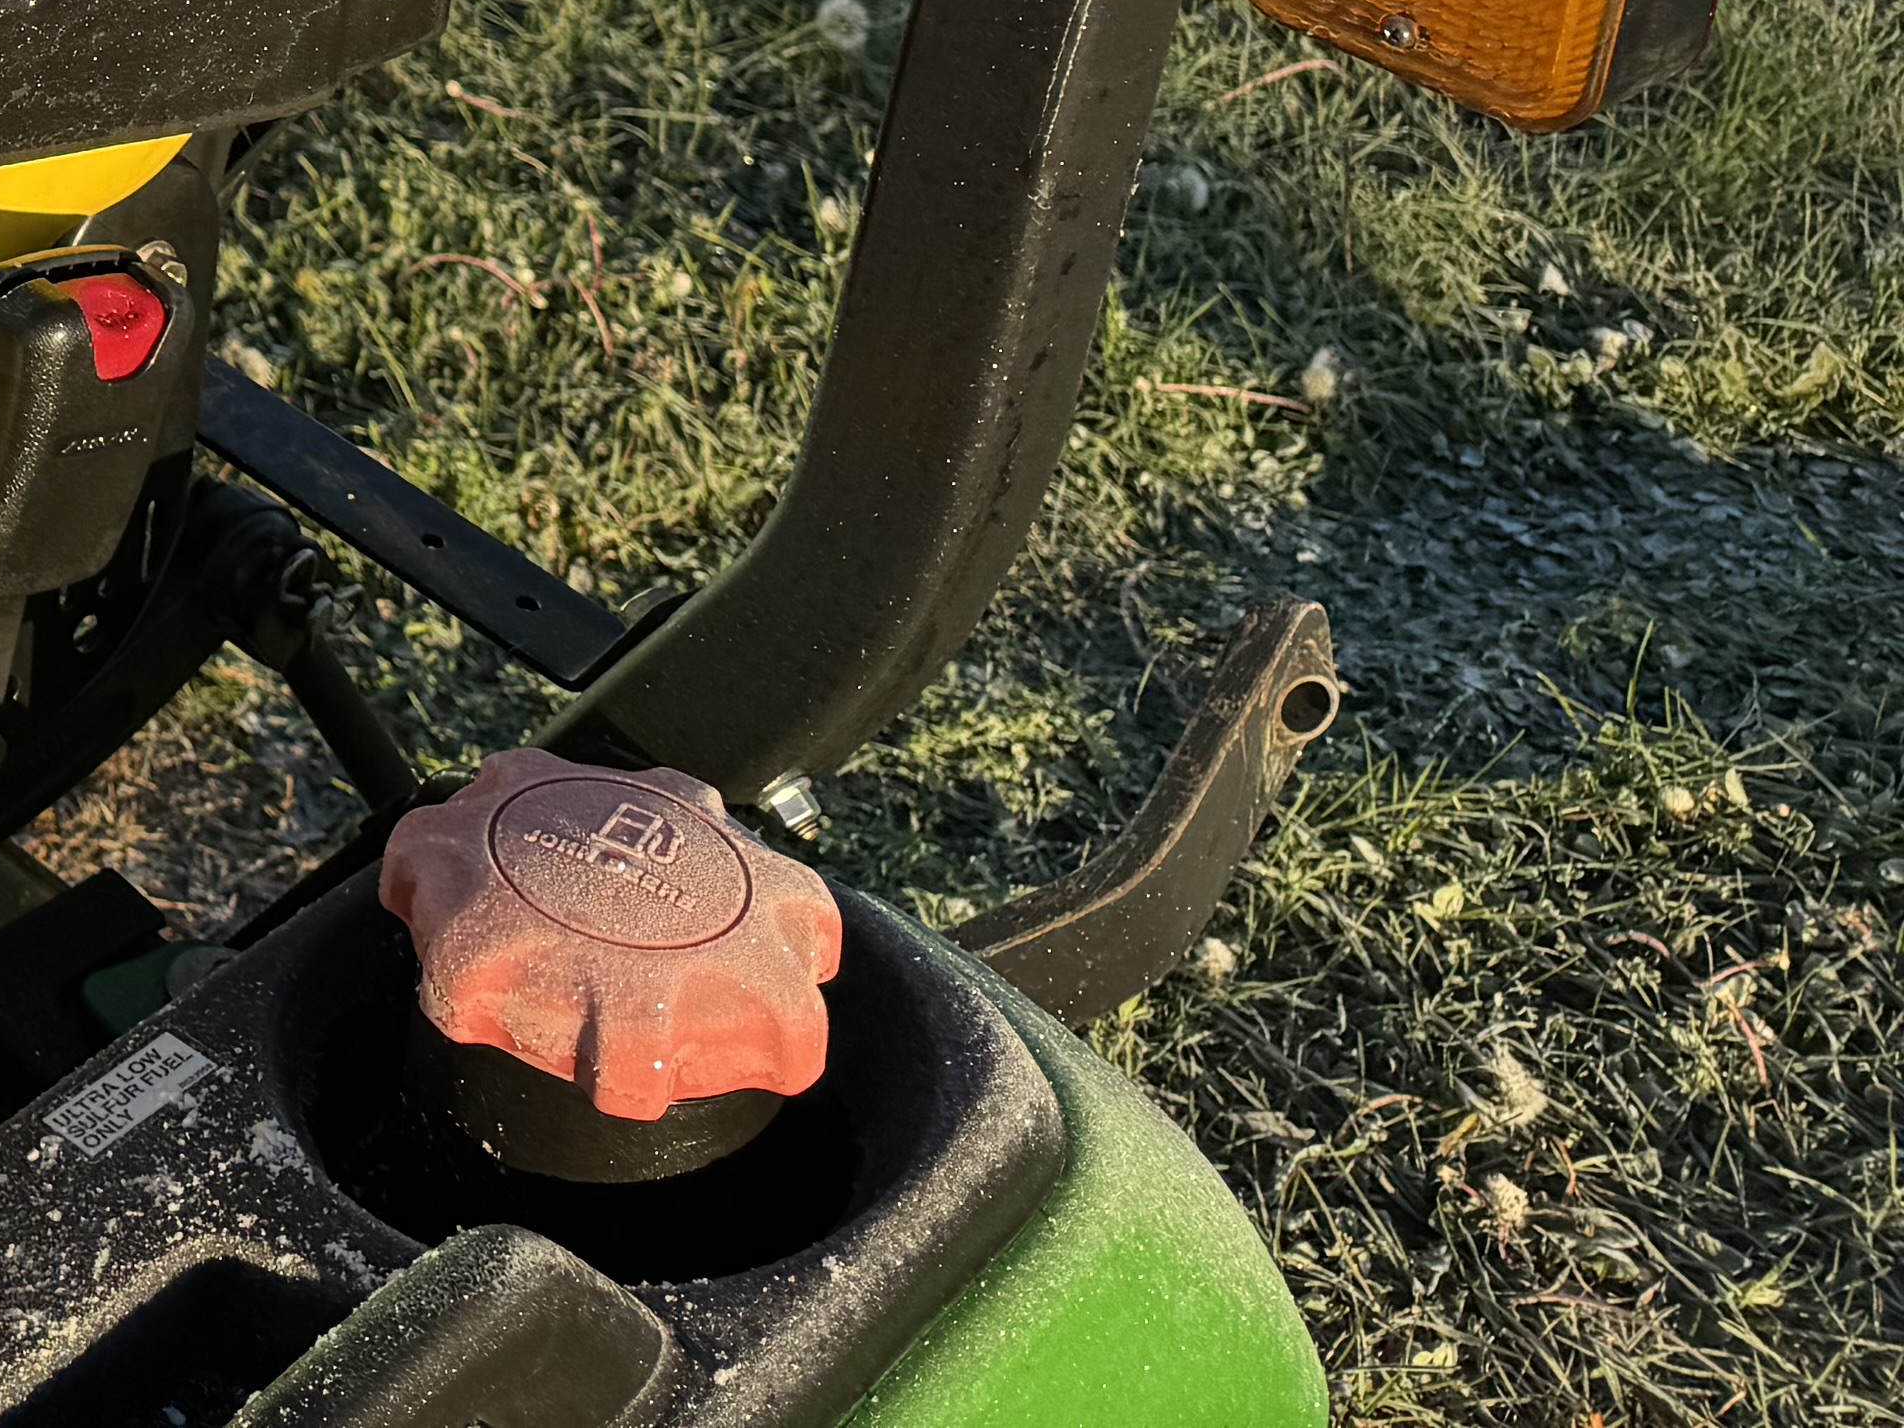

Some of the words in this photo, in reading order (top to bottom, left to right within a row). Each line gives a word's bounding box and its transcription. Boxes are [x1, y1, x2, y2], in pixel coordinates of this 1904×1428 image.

[52, 1082, 120, 1127] ULTRA
[115, 1047, 163, 1083] LOW
[67, 1083, 145, 1138] SULFUR
[140, 1051, 194, 1087] FUEL
[82, 1108, 134, 1148] ONLY
